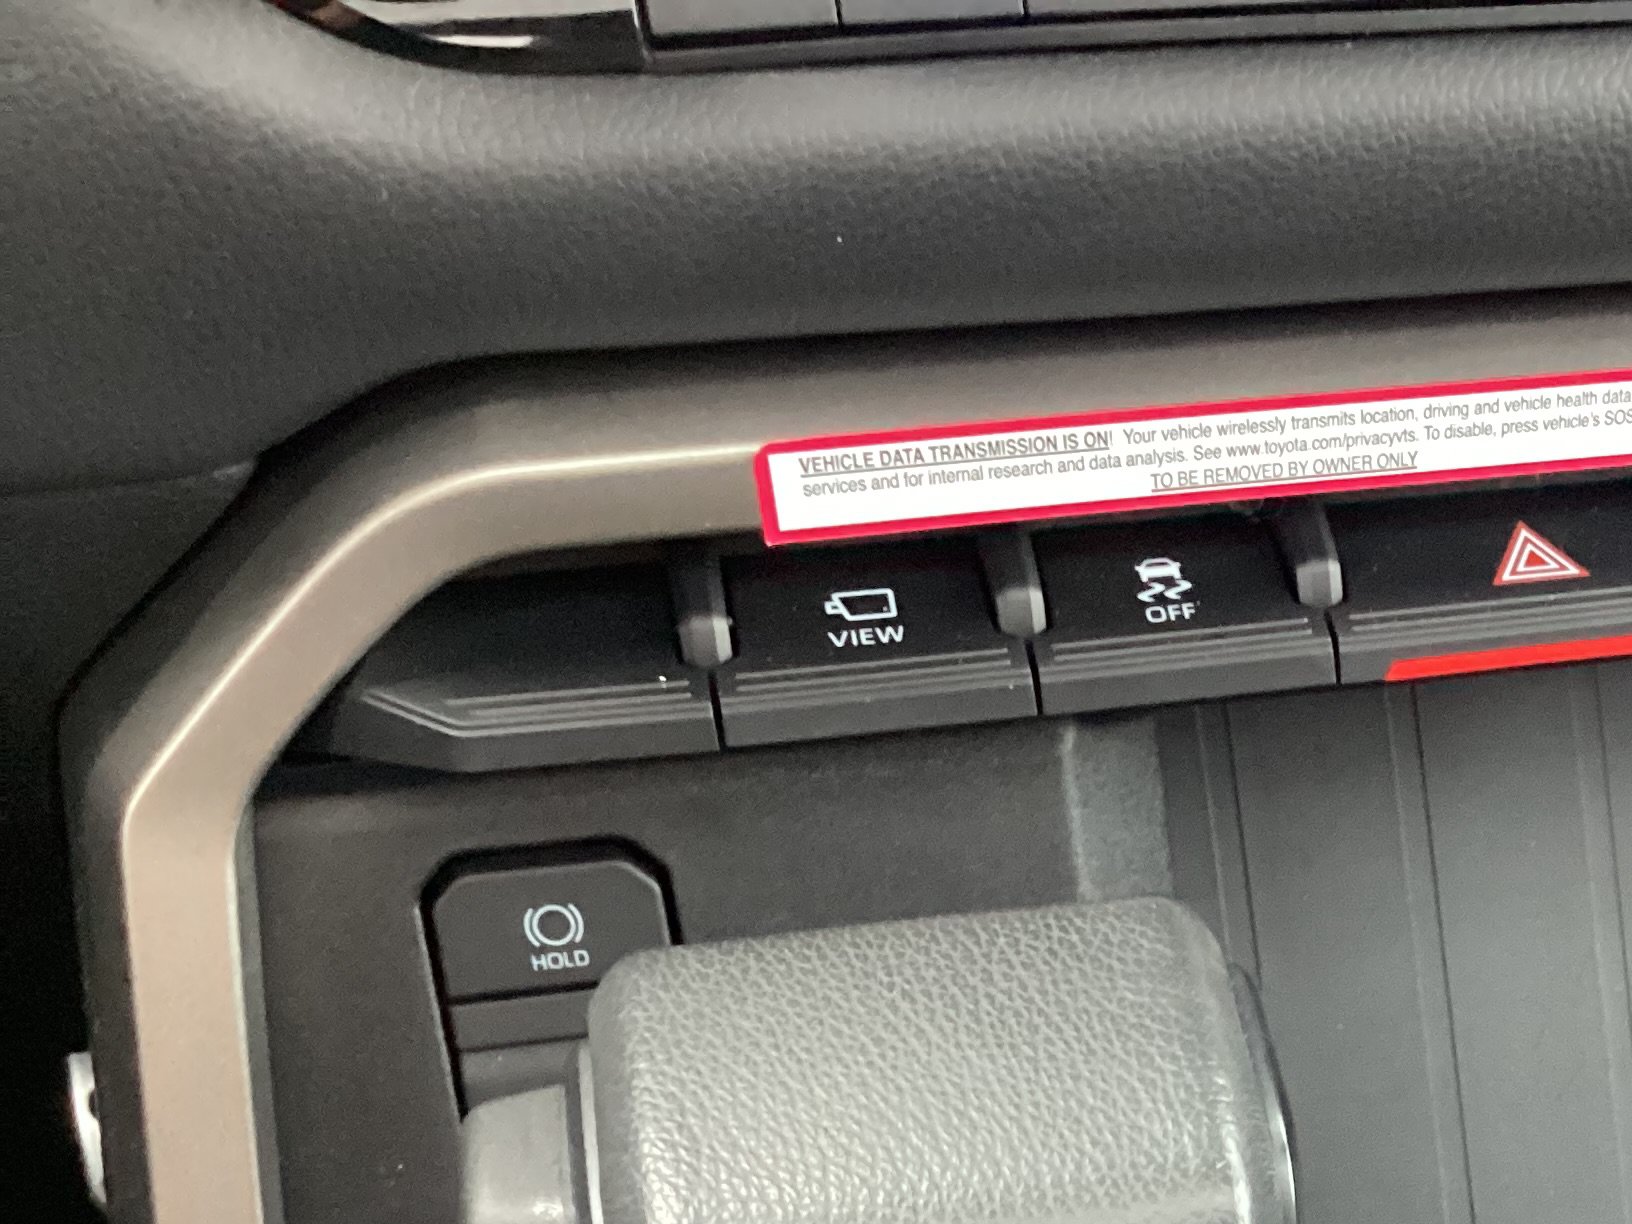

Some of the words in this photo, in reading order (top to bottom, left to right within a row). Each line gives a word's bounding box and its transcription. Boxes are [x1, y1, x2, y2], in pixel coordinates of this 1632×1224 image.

[798, 452, 875, 474] VEHICLE
[880, 447, 925, 467] DATA
[928, 435, 1059, 462] TRANSMISSION
[1063, 433, 1079, 450] IS
[1084, 429, 1113, 448] ON!
[1123, 427, 1158, 445] Your
[1161, 422, 1212, 442] vehicle
[1216, 416, 1287, 436] wirelessly
[1291, 410, 1356, 429] transmits
[1360, 406, 1418, 424] location,
[1423, 402, 1469, 420] driving
[1474, 398, 1499, 415] and
[1504, 395, 1552, 413] vehicle
[1557, 391, 1598, 408] health
[1602, 388, 1632, 405] data
[803, 476, 868, 497] services
[871, 473, 900, 491] and
[903, 471, 924, 488] for
[928, 466, 985, 485] internal
[988, 459, 1053, 479] research
[1057, 456, 1086, 473] and
[1089, 453, 1122, 470] data
[1126, 448, 1188, 468] analysis.
[1193, 445, 1222, 461] See
[1226, 429, 1419, 457] www.toyota.com/privacyvts.
[1424, 424, 1441, 441] To
[1444, 421, 1497, 440] disable,
[1501, 417, 1539, 438] press
[1542, 412, 1600, 431] vehicle's
[1150, 472, 1173, 489] TO
[1178, 469, 1199, 487] BE
[1203, 462, 1284, 484] REMOVED
[1289, 461, 1308, 477] BY
[1313, 454, 1373, 475] OWNER
[1377, 451, 1418, 470] ONLY
[1144, 602, 1196, 624] OFF
[827, 625, 904, 648] VIEW
[530, 949, 590, 971] HOLD
